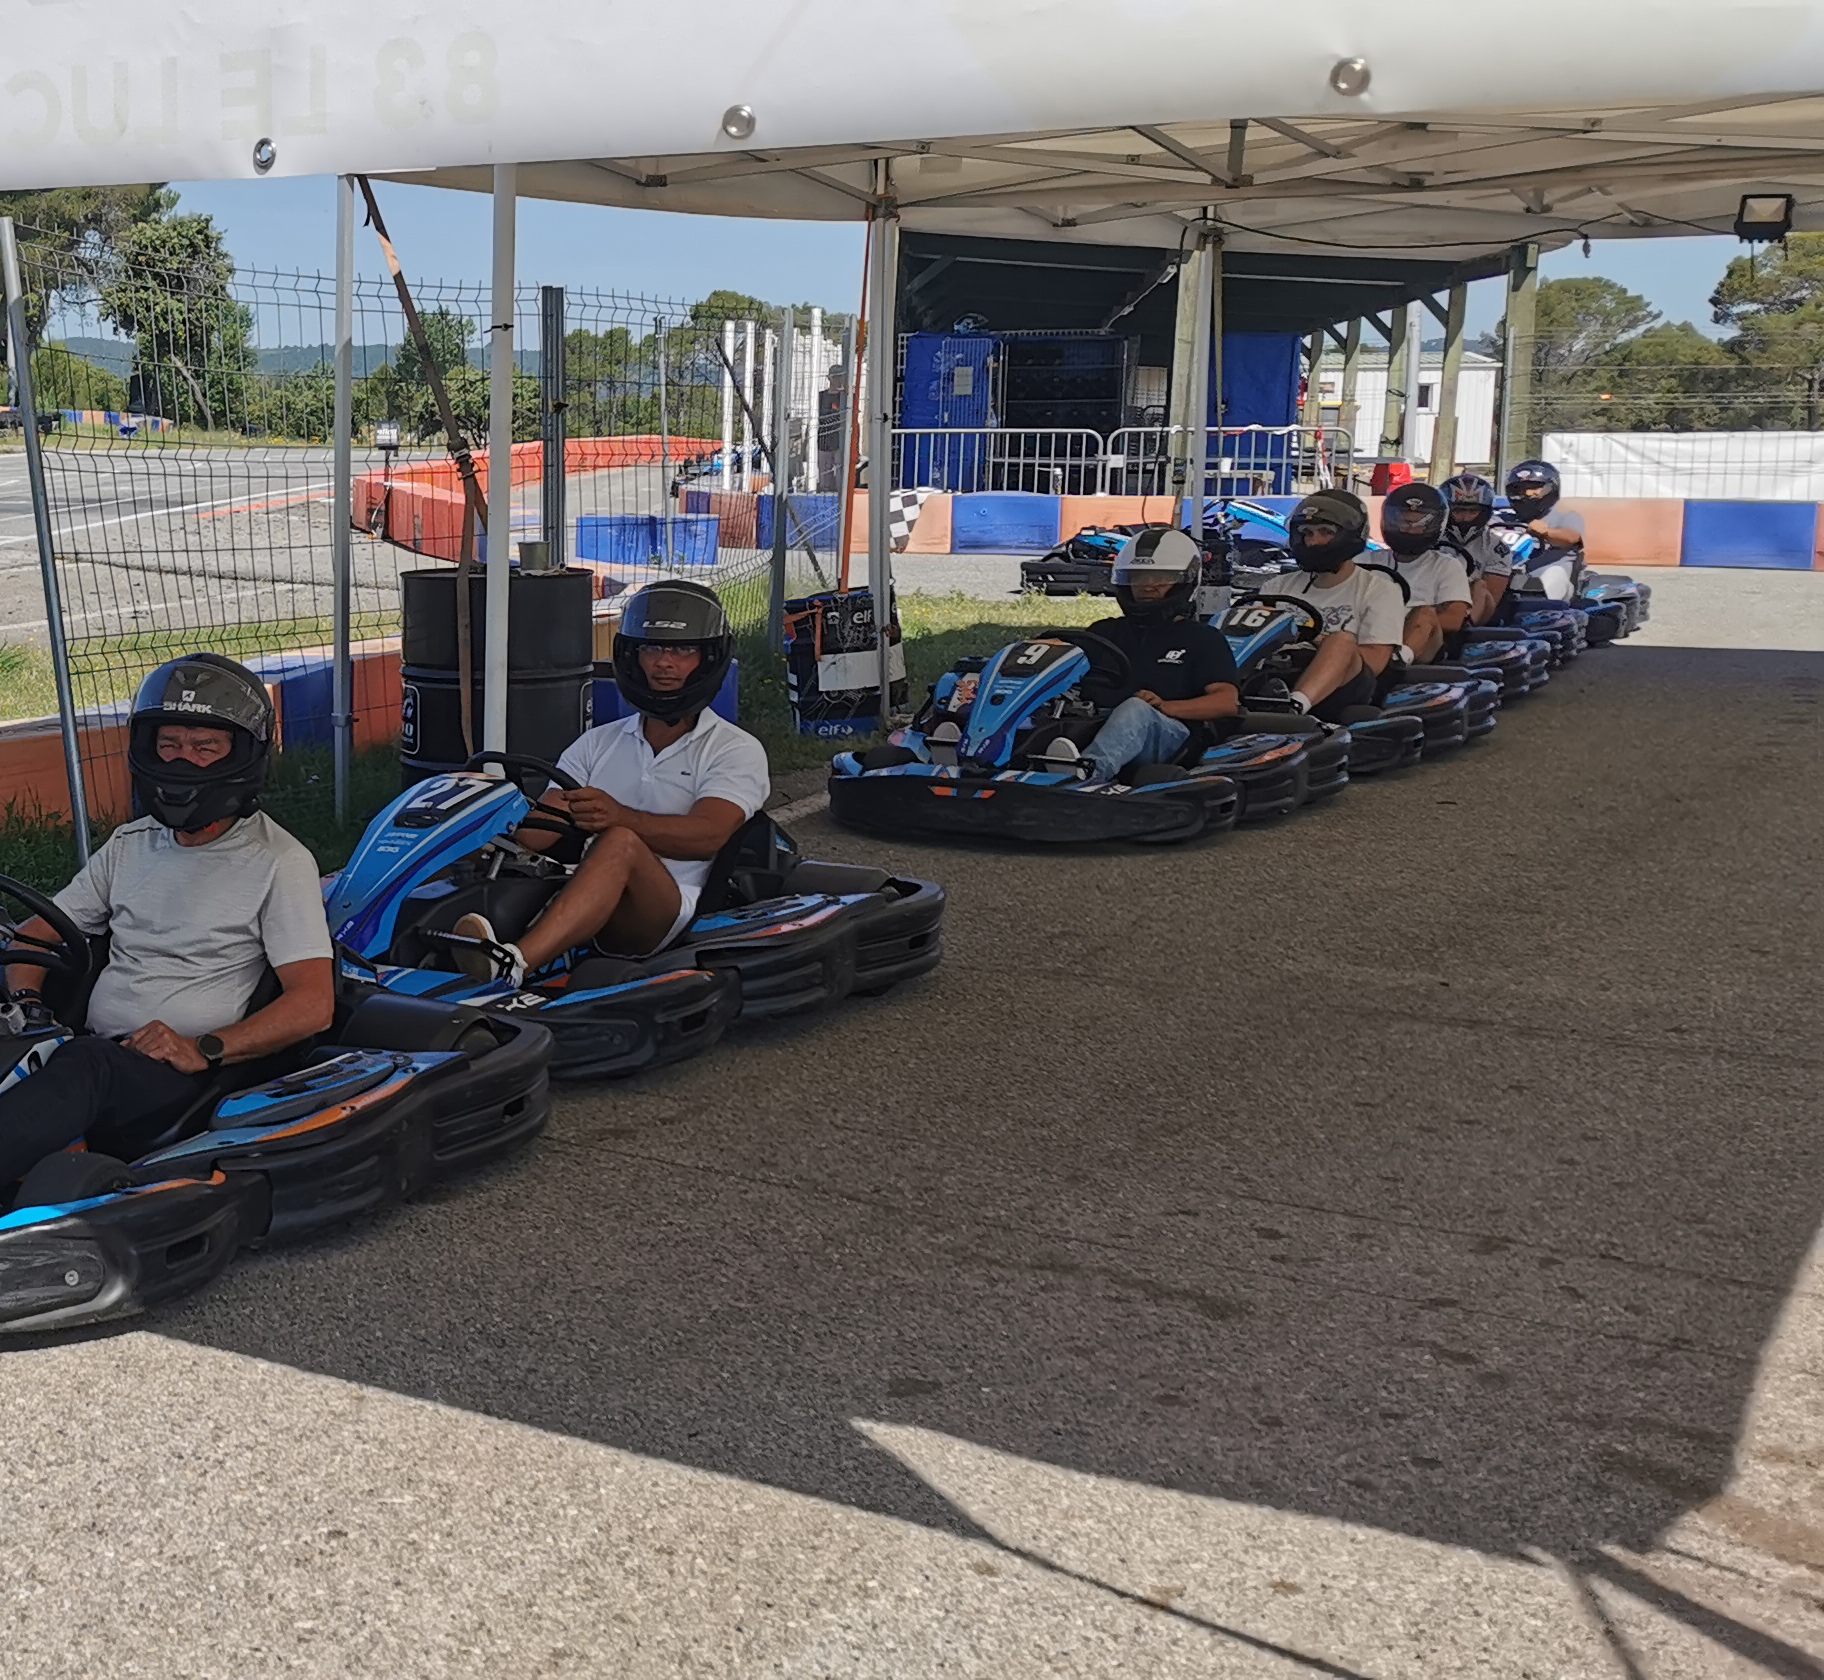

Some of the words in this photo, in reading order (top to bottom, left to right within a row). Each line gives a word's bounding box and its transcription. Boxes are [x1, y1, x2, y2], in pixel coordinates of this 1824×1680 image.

[852, 608, 873, 624] elf
[1228, 608, 1271, 628] 16
[1016, 643, 1051, 666] 9
[162, 700, 212, 715] SHARK
[818, 723, 840, 736] elf
[406, 777, 494, 811] 27
